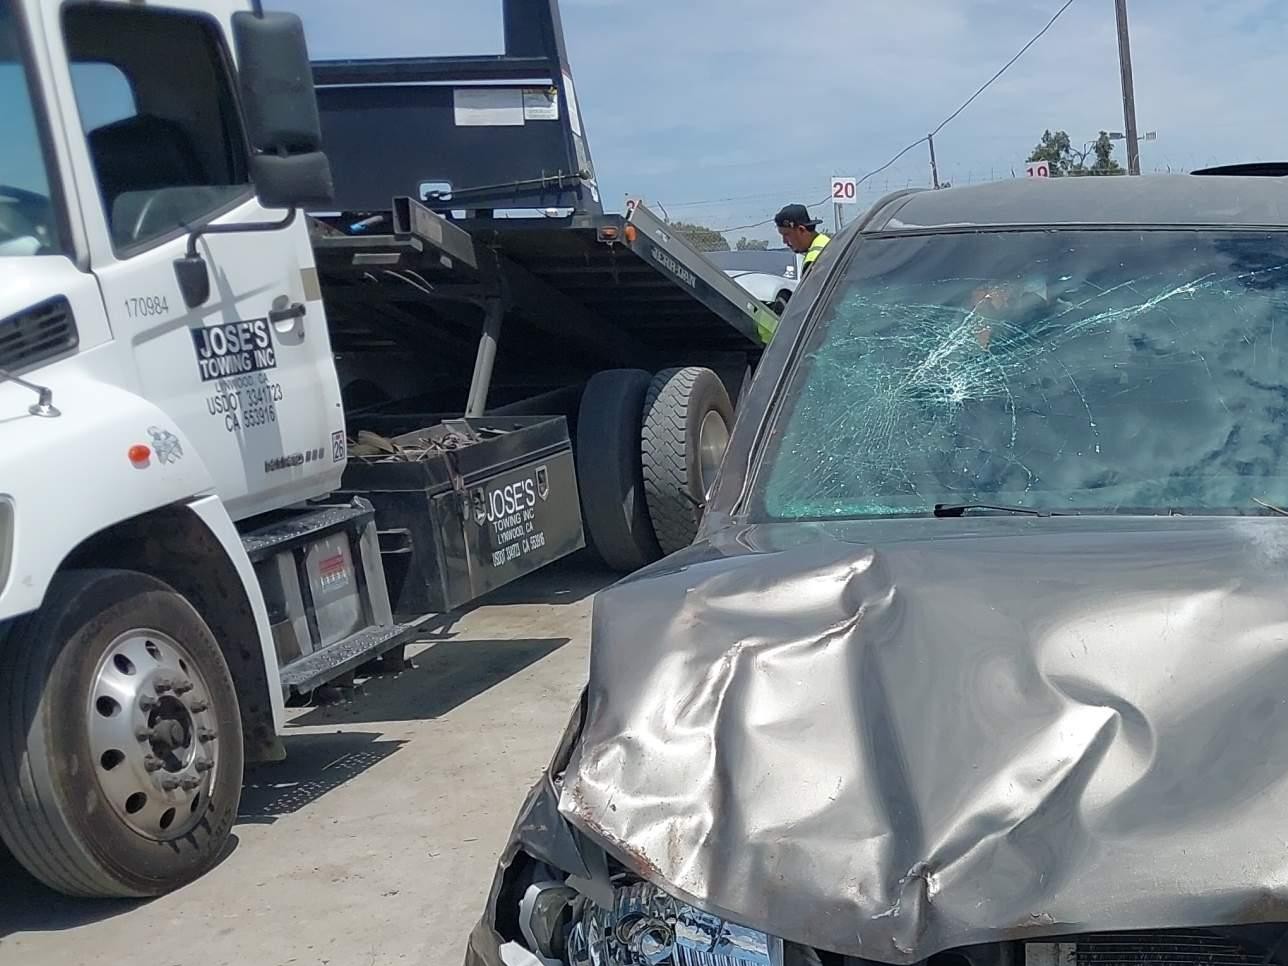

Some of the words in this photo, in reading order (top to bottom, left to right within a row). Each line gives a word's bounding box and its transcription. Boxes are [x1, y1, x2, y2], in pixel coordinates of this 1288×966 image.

[833, 182, 855, 198] 20
[124, 296, 169, 318] 170984
[200, 320, 269, 358] JOSE'S
[200, 353, 252, 379] TOWING
[254, 348, 275, 368] INC
[207, 391, 243, 415] USDOT
[225, 413, 241, 433] CA
[335, 440, 344, 459] 26
[488, 479, 536, 521] JOSE'S
[493, 512, 522, 534] TOWING
[523, 508, 535, 522] INC
[526, 521, 534, 534] CA
